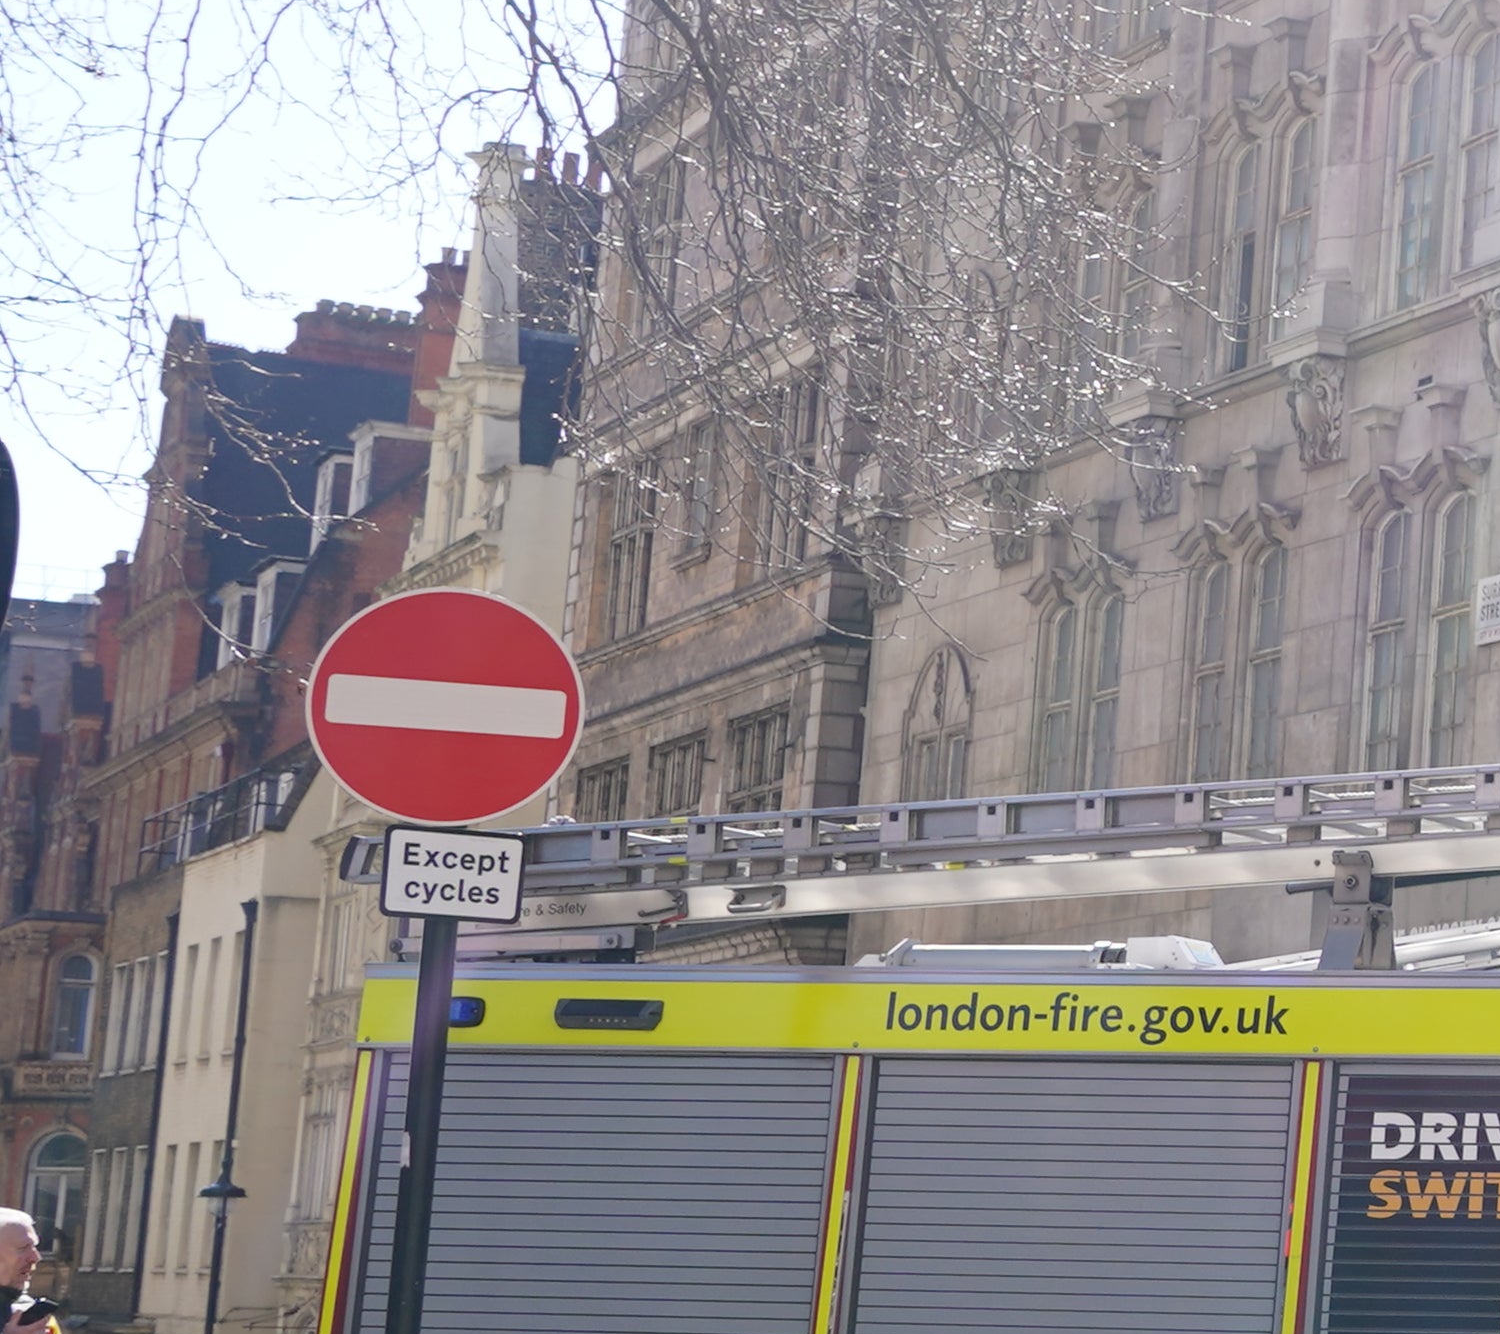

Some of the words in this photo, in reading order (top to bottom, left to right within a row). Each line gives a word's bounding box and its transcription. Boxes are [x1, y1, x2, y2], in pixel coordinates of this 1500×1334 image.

[402, 842, 510, 877] Except
[403, 879, 500, 906] cycles
[535, 904, 544, 917] &
[547, 902, 588, 918] Safety
[885, 990, 1290, 1045] london-fire.gov.uk
